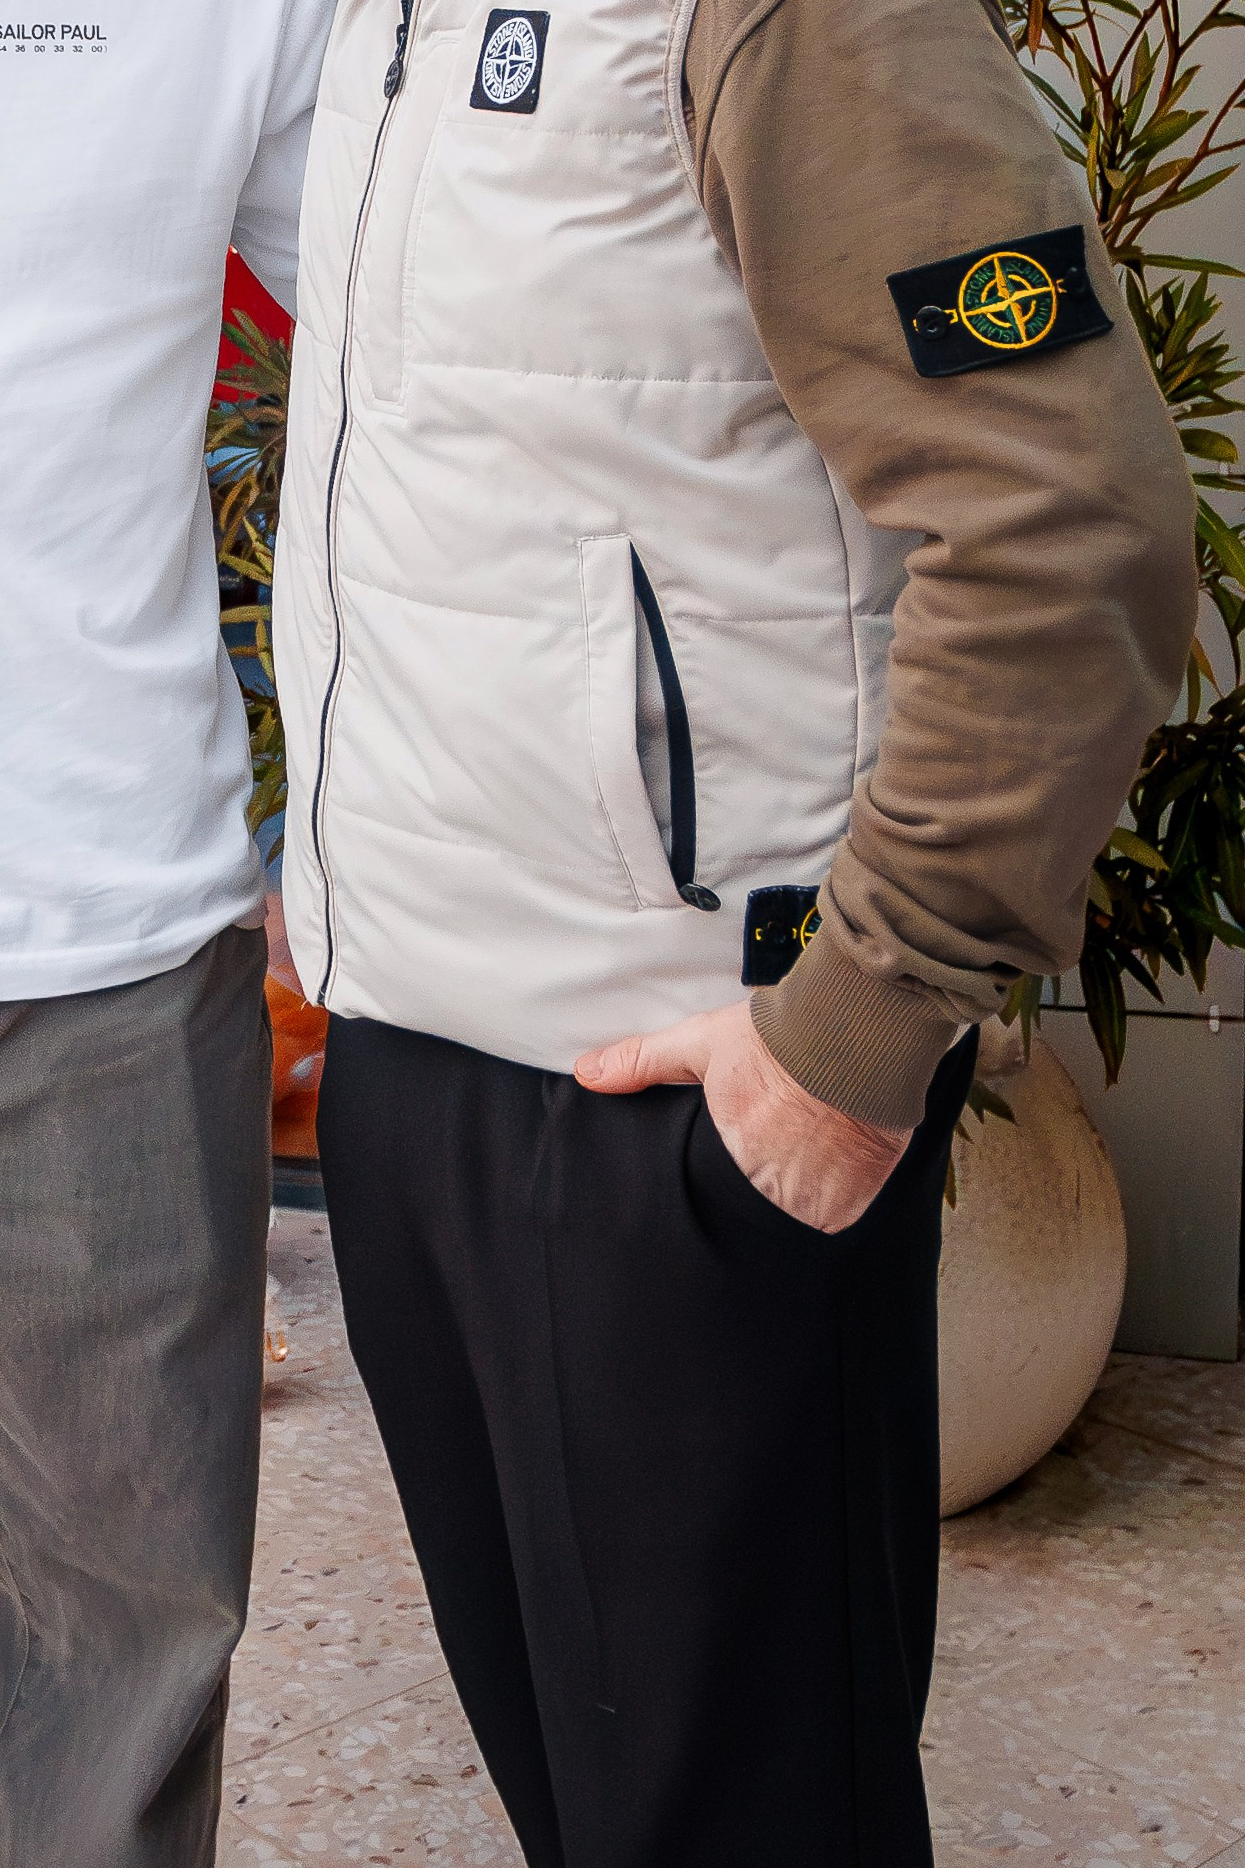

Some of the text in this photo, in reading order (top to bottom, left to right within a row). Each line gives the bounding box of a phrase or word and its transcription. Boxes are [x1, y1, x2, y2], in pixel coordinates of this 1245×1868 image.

[61, 24, 107, 40] PAUL
[487, 22, 534, 58] STONE ISLAND
[485, 61, 531, 97] STONE ISLAND
